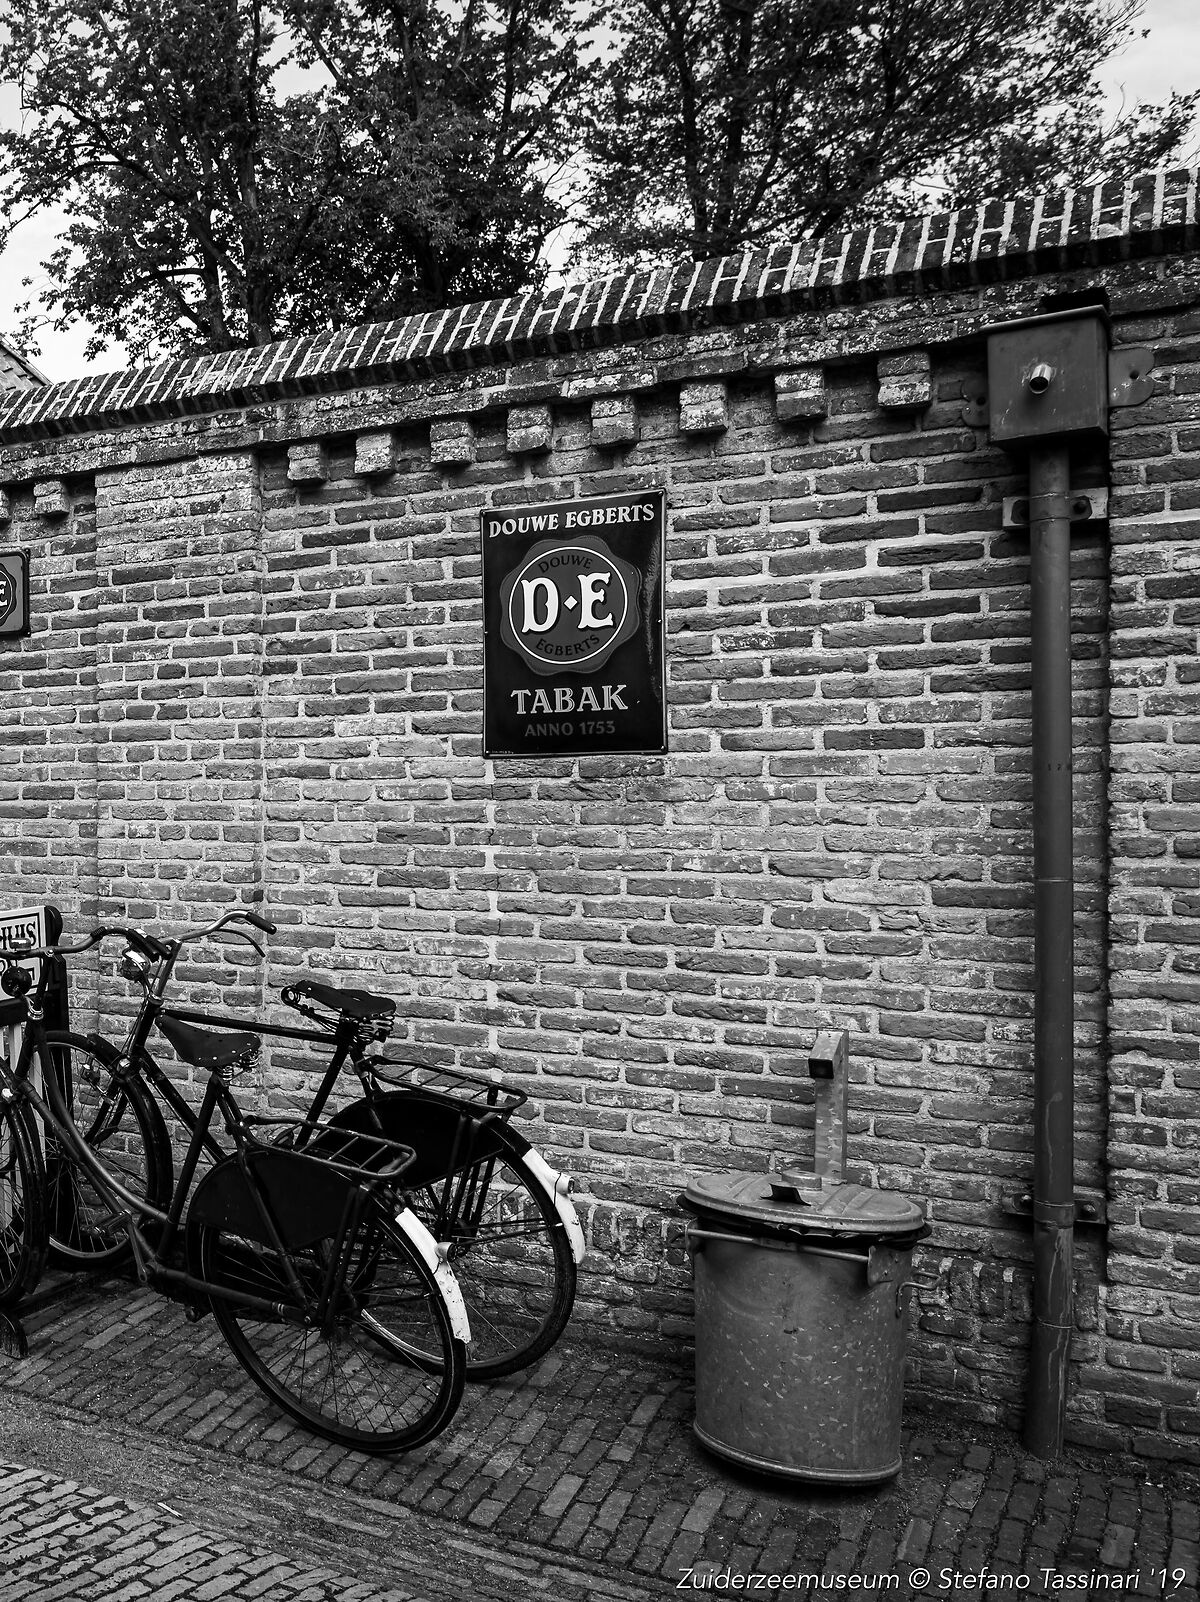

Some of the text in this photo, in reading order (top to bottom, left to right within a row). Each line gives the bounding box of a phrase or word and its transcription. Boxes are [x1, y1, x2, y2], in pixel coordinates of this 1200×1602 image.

[489, 503, 655, 537] DOUWE EGBERTS
[538, 554, 593, 574] DOUWE
[535, 634, 600, 656] EGBERTS
[510, 684, 629, 715] TABAK
[524, 720, 616, 737] ANNO 1753
